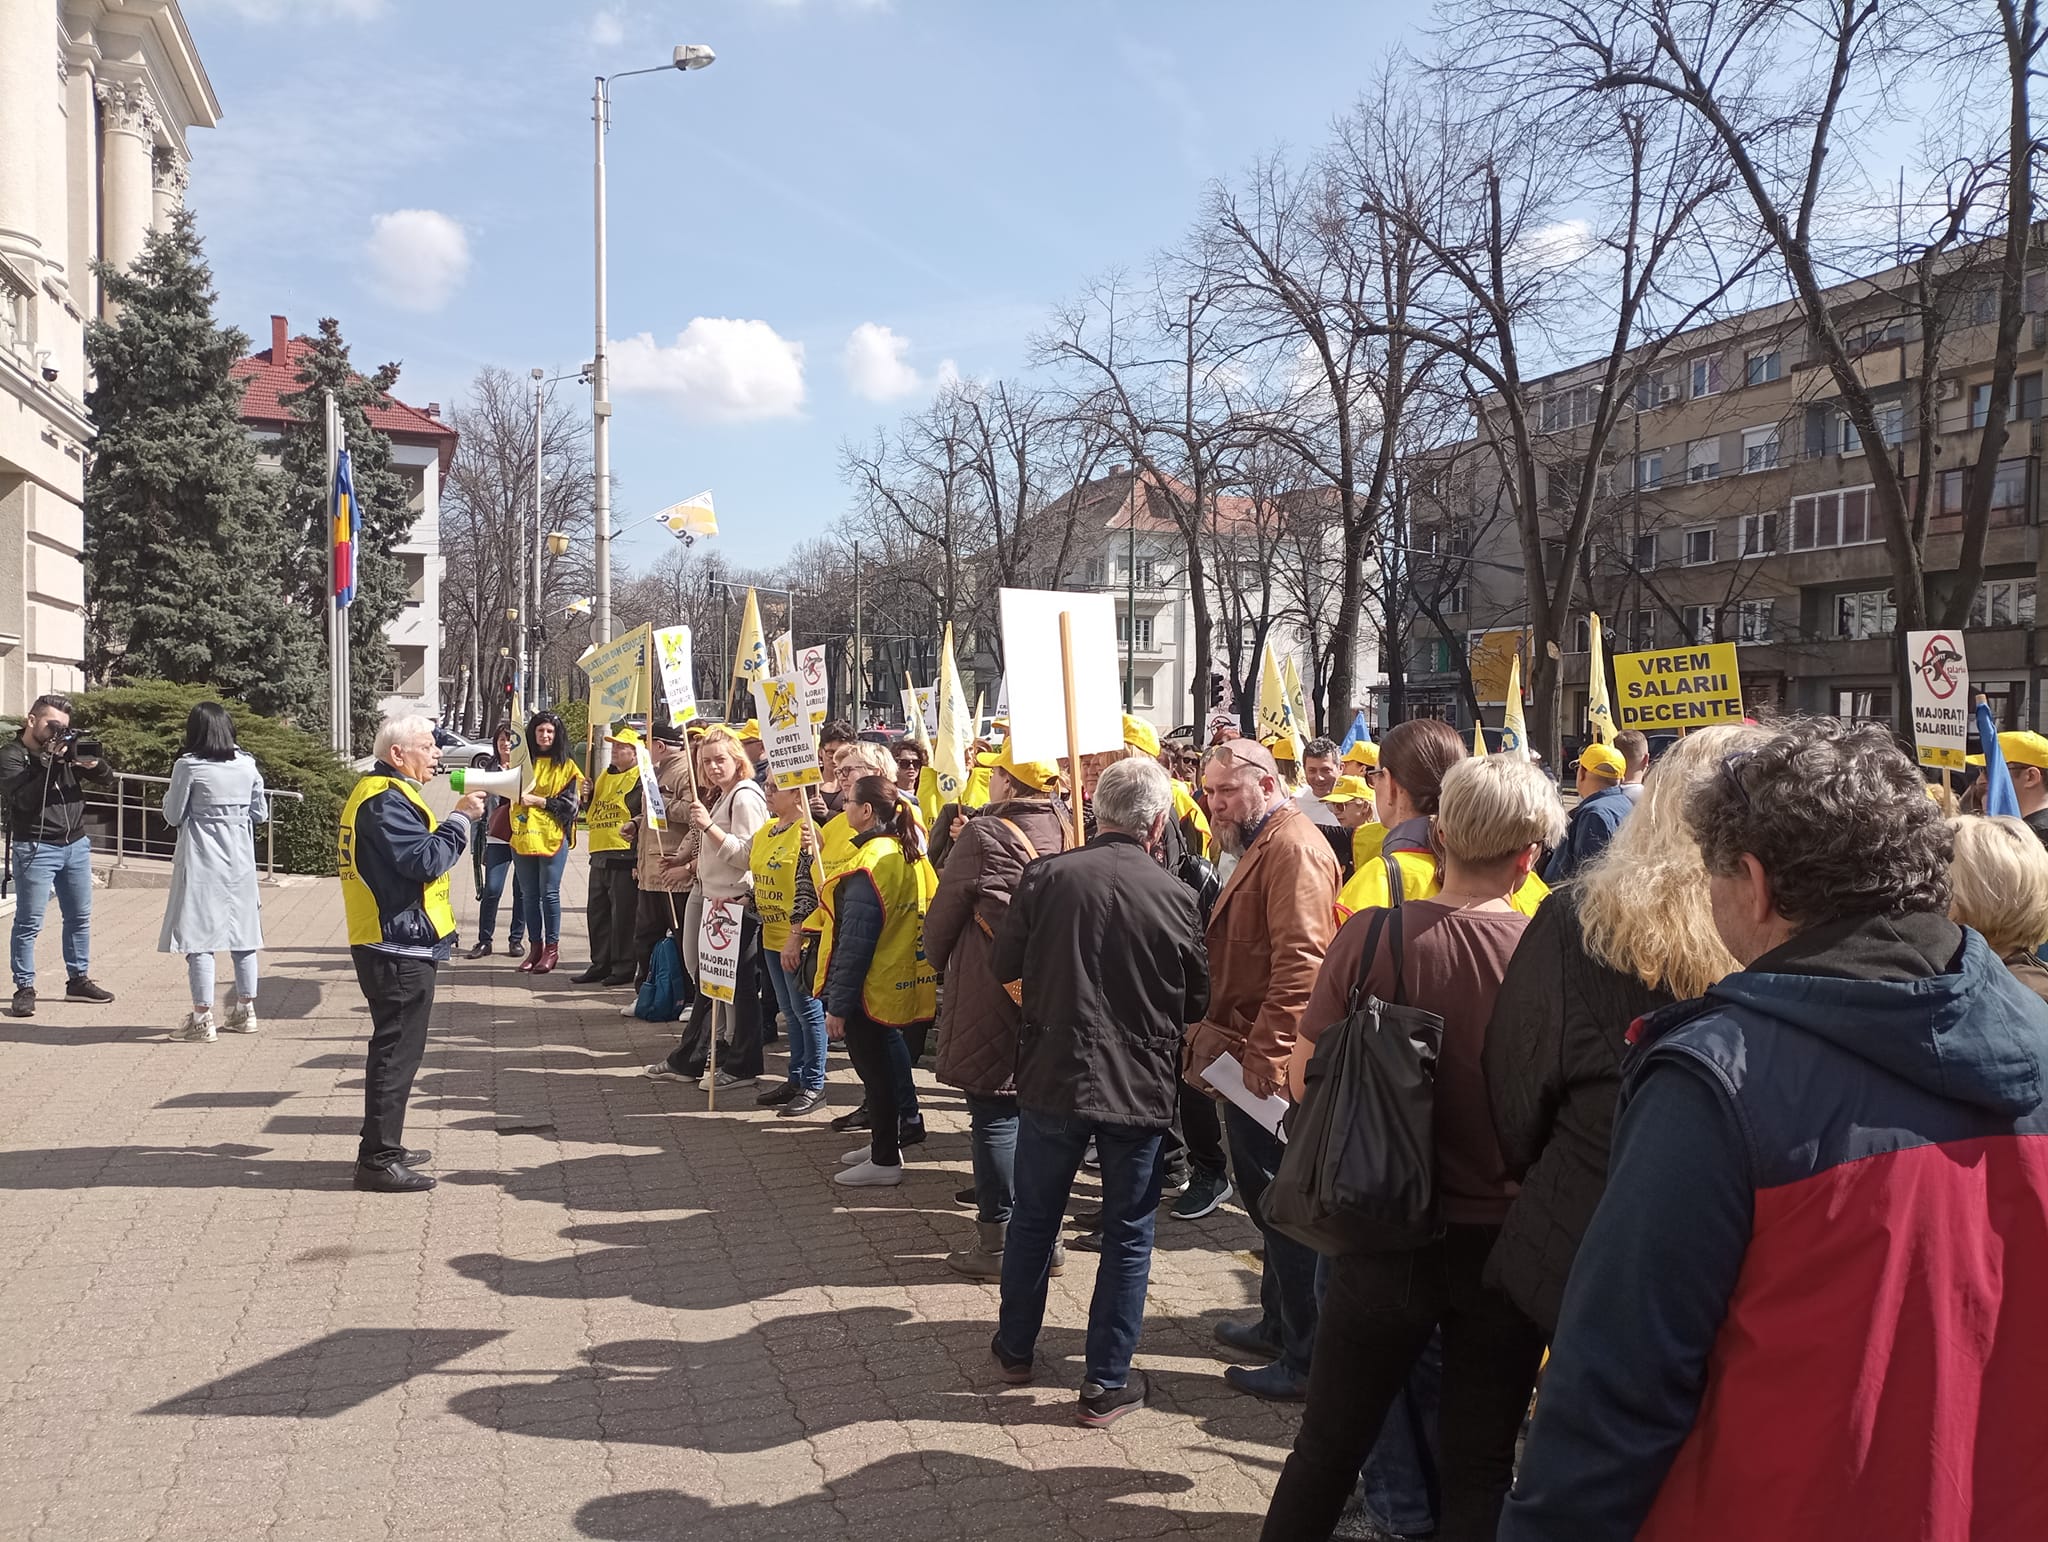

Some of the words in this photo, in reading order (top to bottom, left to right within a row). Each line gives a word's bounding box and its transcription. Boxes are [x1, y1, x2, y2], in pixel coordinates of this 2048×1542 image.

[1638, 653, 1710, 675] VREM
[1628, 674, 1728, 698] SALARII
[1623, 698, 1741, 723] DECENTE
[1916, 707, 1964, 723] MAJORAȚI
[770, 743, 809, 758] CREȘTEREA
